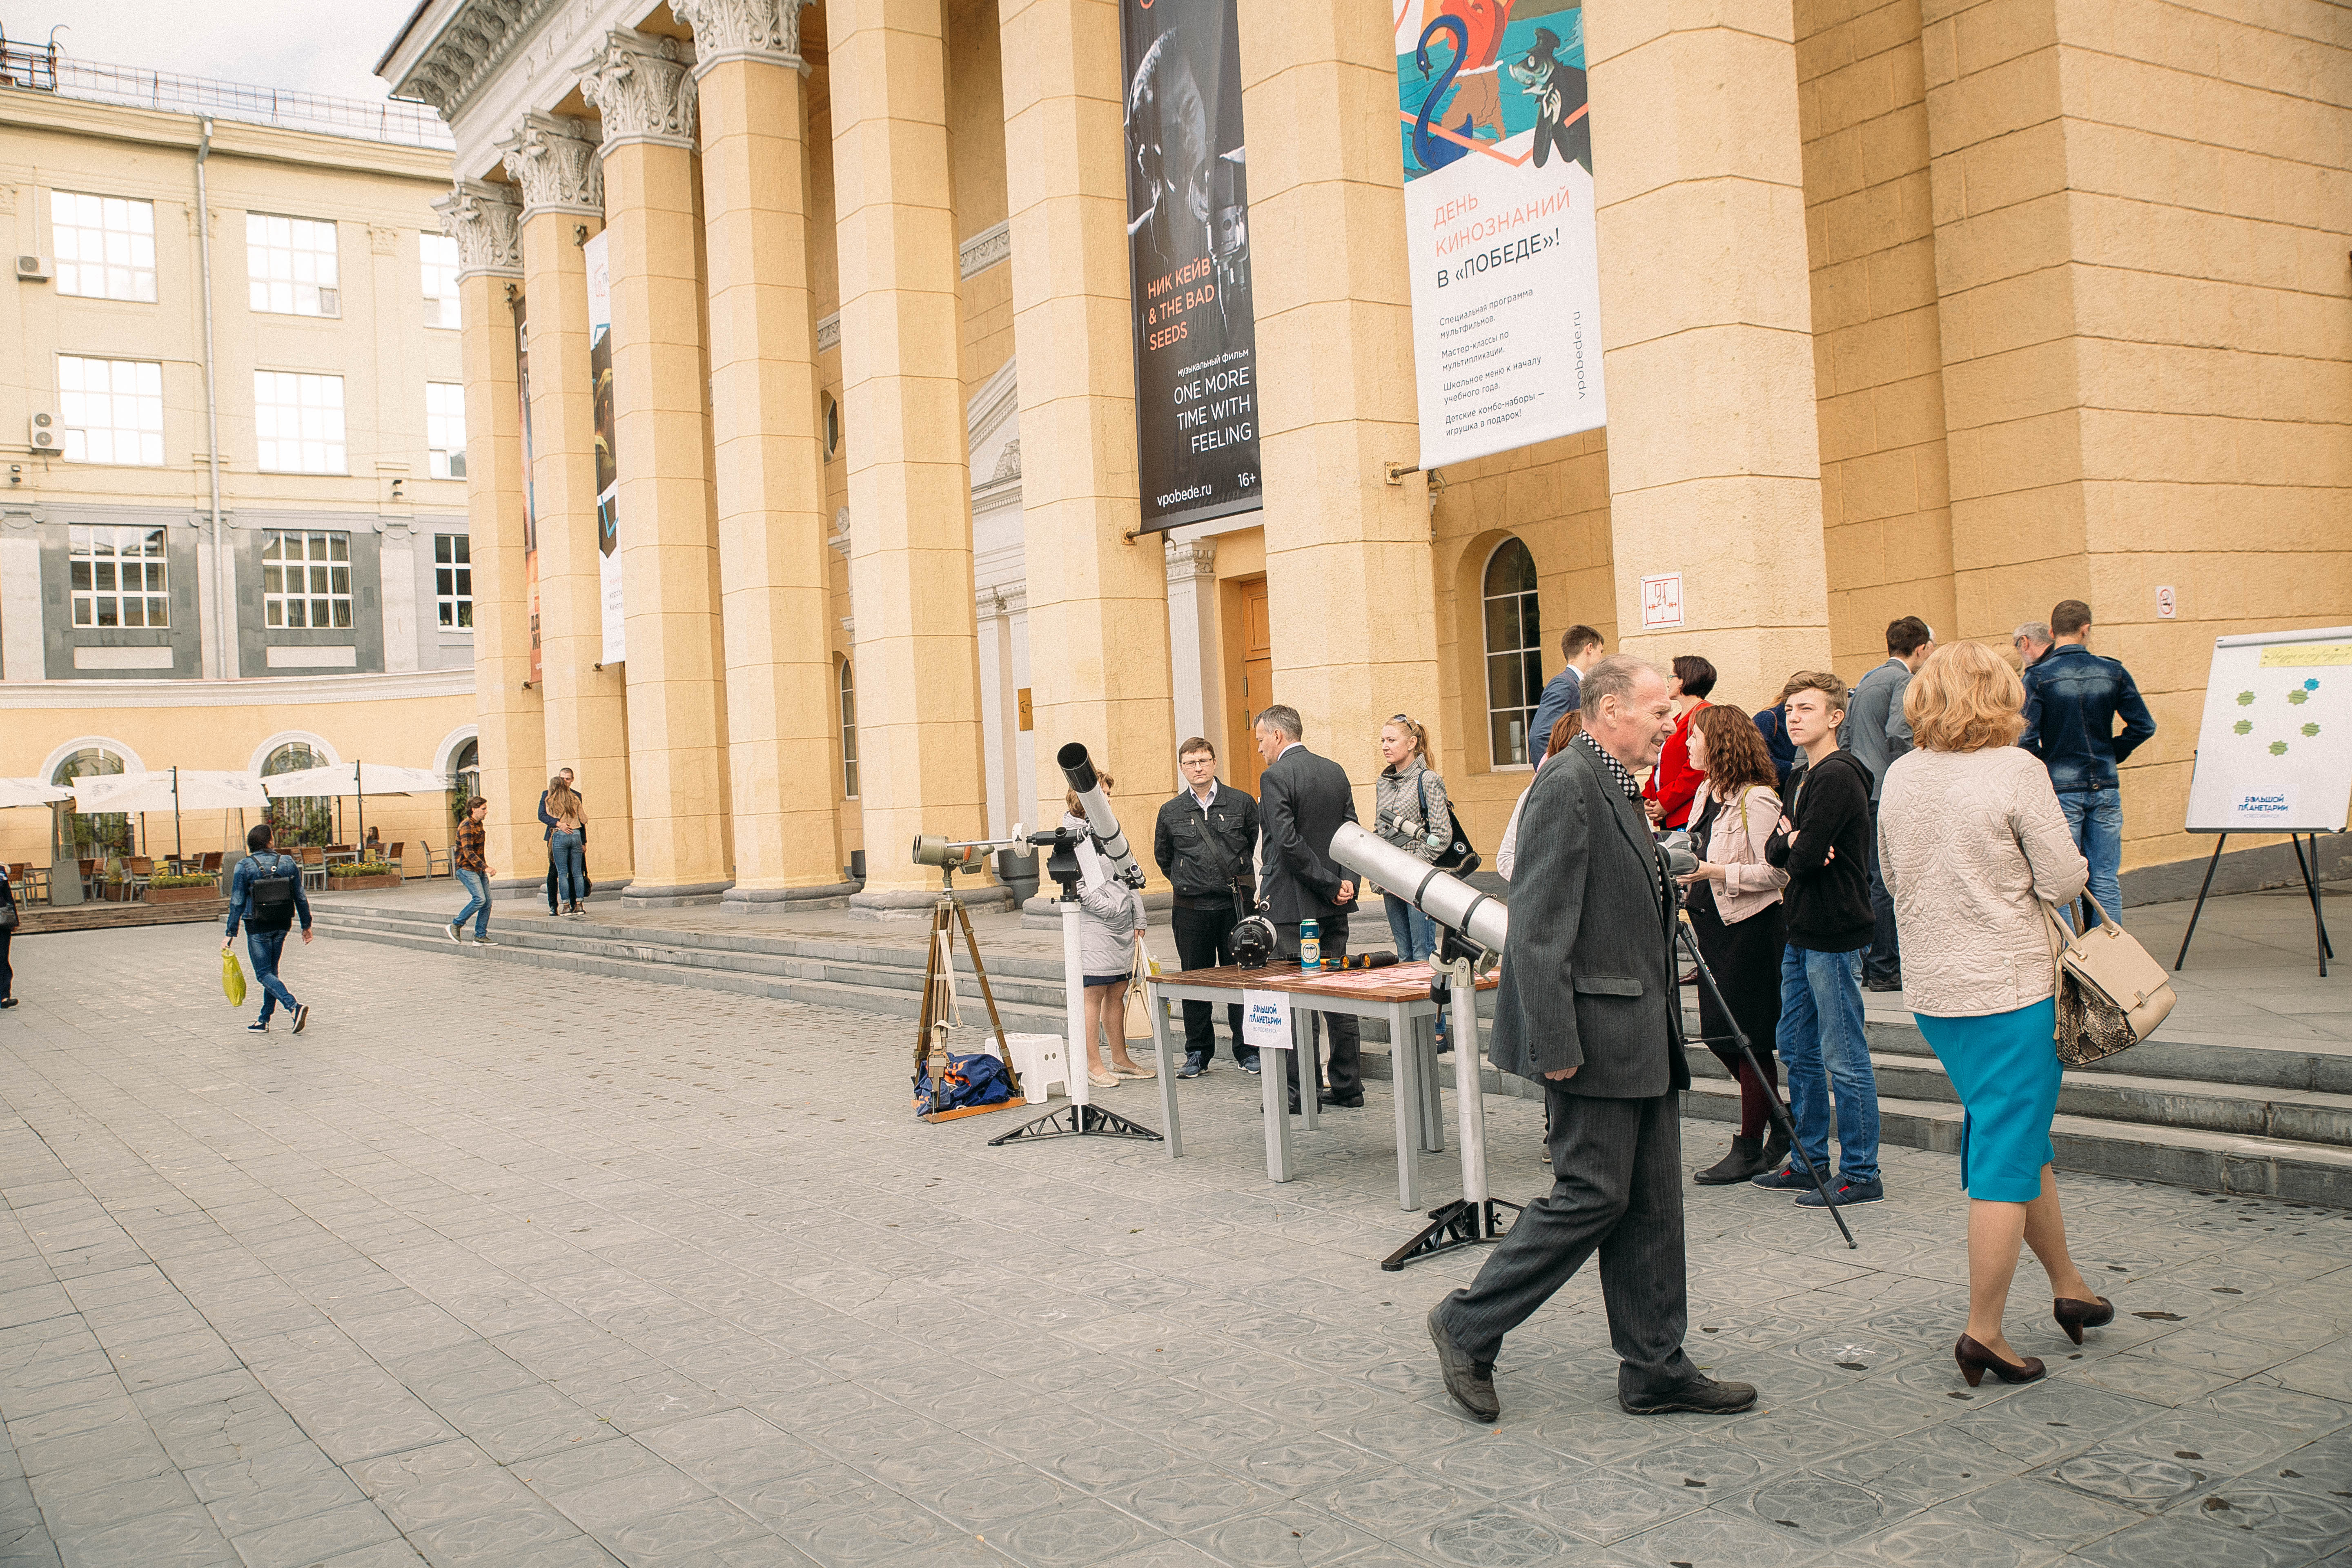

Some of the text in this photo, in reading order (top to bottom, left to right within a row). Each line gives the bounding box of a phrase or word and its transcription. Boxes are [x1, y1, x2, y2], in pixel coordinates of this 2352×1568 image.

[1434, 194, 1478, 229] ДЕНЬ
[1436, 185, 1570, 257] КИНОЗНАНИЙ
[1438, 227, 1559, 288] В «ПОБЕДЕ»!
[1148, 257, 1211, 300] НИК КЕЙВ
[1148, 284, 1215, 325] & THE BAD
[1439, 289, 1533, 326] Специальная программа
[1150, 321, 1187, 351] SEEDS
[1441, 315, 1495, 339] мультфильмов.
[1442, 331, 1509, 359] Мастер-классы по
[1443, 347, 1505, 371] мультипликации.
[1573, 311, 1587, 400] vpobede.ru
[1178, 349, 1249, 378] музыкальный фильм
[1444, 374, 1483, 391] Школьное
[1485, 368, 1504, 379] меню
[1513, 356, 1541, 370] началу
[1174, 366, 1250, 404] ONE MORE
[1444, 383, 1500, 405] учебного года.
[1176, 394, 1250, 430] TIME WITH
[1446, 409, 1476, 425] Детские
[1479, 393, 1535, 415] комбо-наборы
[1446, 422, 1478, 436] игрушка
[1487, 409, 1522, 425] подарок!
[1192, 422, 1252, 454] FEELING
[1238, 472, 1256, 487] 16+
[1157, 484, 1212, 508] vpobede.ru
[2245, 794, 2284, 803] БОЛЬШОЙ
[1253, 1003, 1277, 1014] БОЛЬШОЙ
